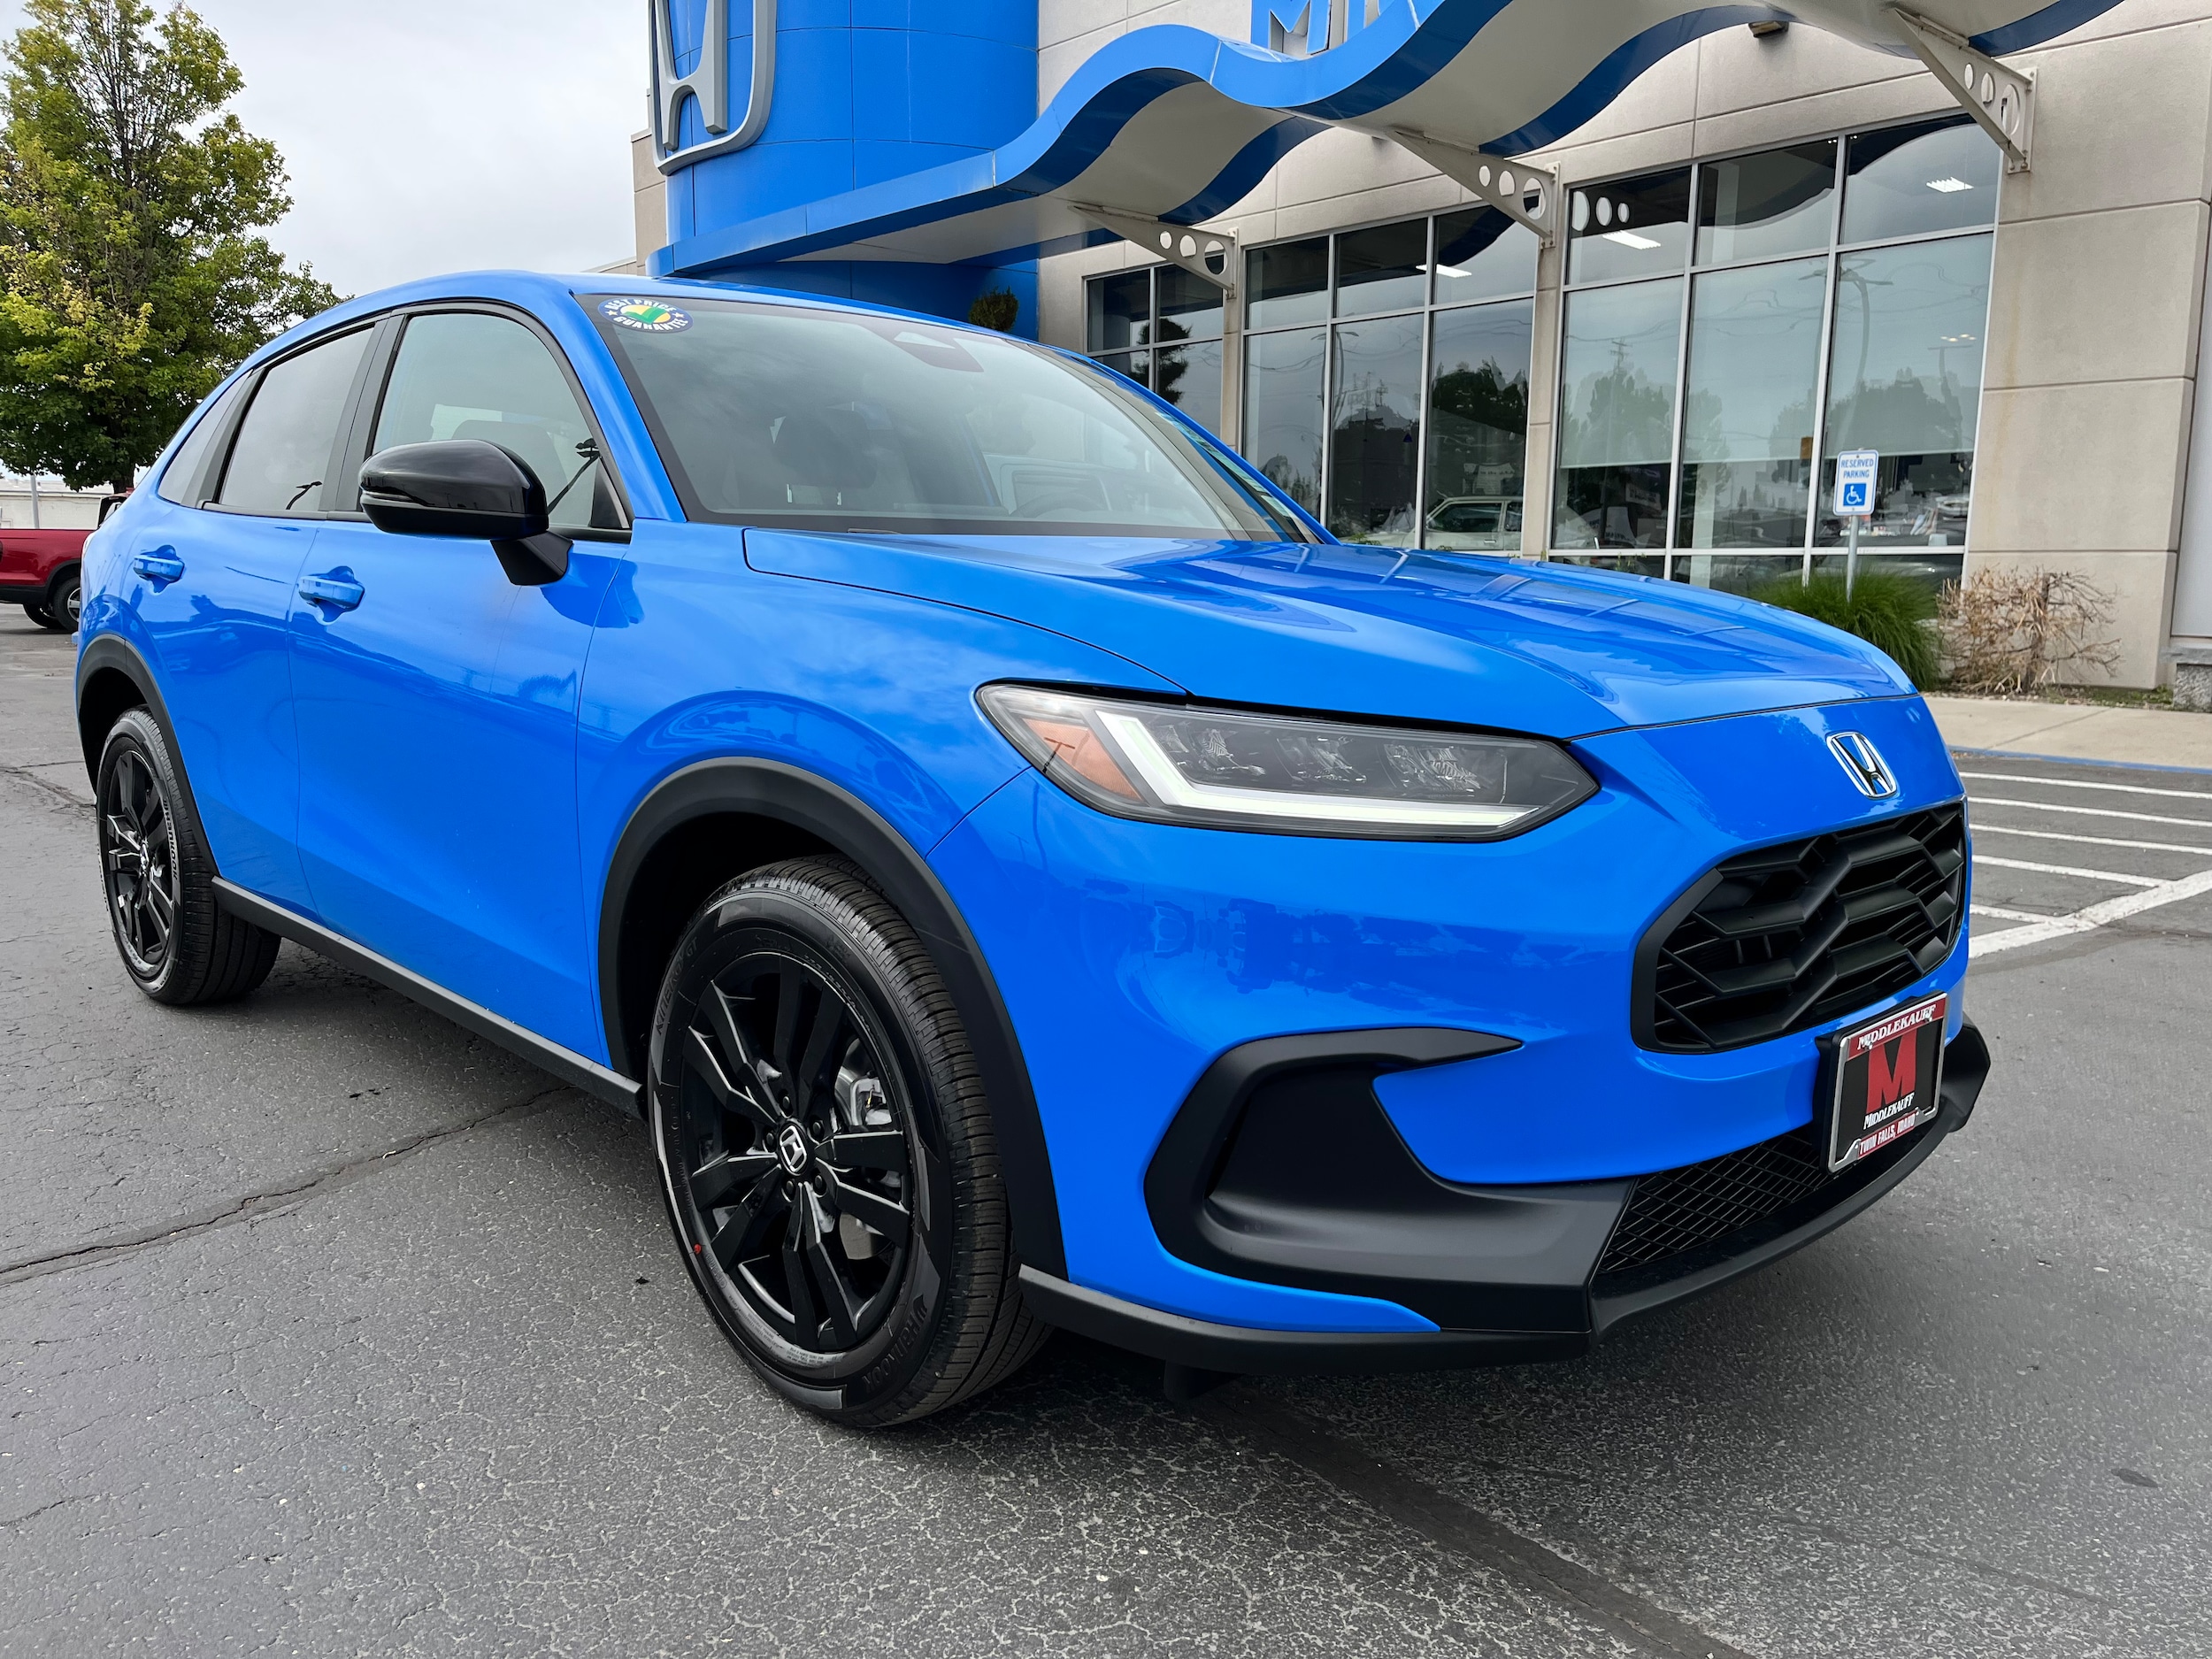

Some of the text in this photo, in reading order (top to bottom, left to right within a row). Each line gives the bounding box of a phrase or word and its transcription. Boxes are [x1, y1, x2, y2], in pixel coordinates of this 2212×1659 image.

[604, 298, 677, 313] BEST PRICE
[613, 316, 688, 331] GUARANTEE
[1841, 458, 1874, 468] RESERVED
[1843, 469, 1870, 479] PARKING
[1866, 1027, 1917, 1114] M
[1863, 1092, 1915, 1130] MIDDLEKAUFF
[1859, 1113, 1916, 1156] TWIN FALLS, IDAHO
